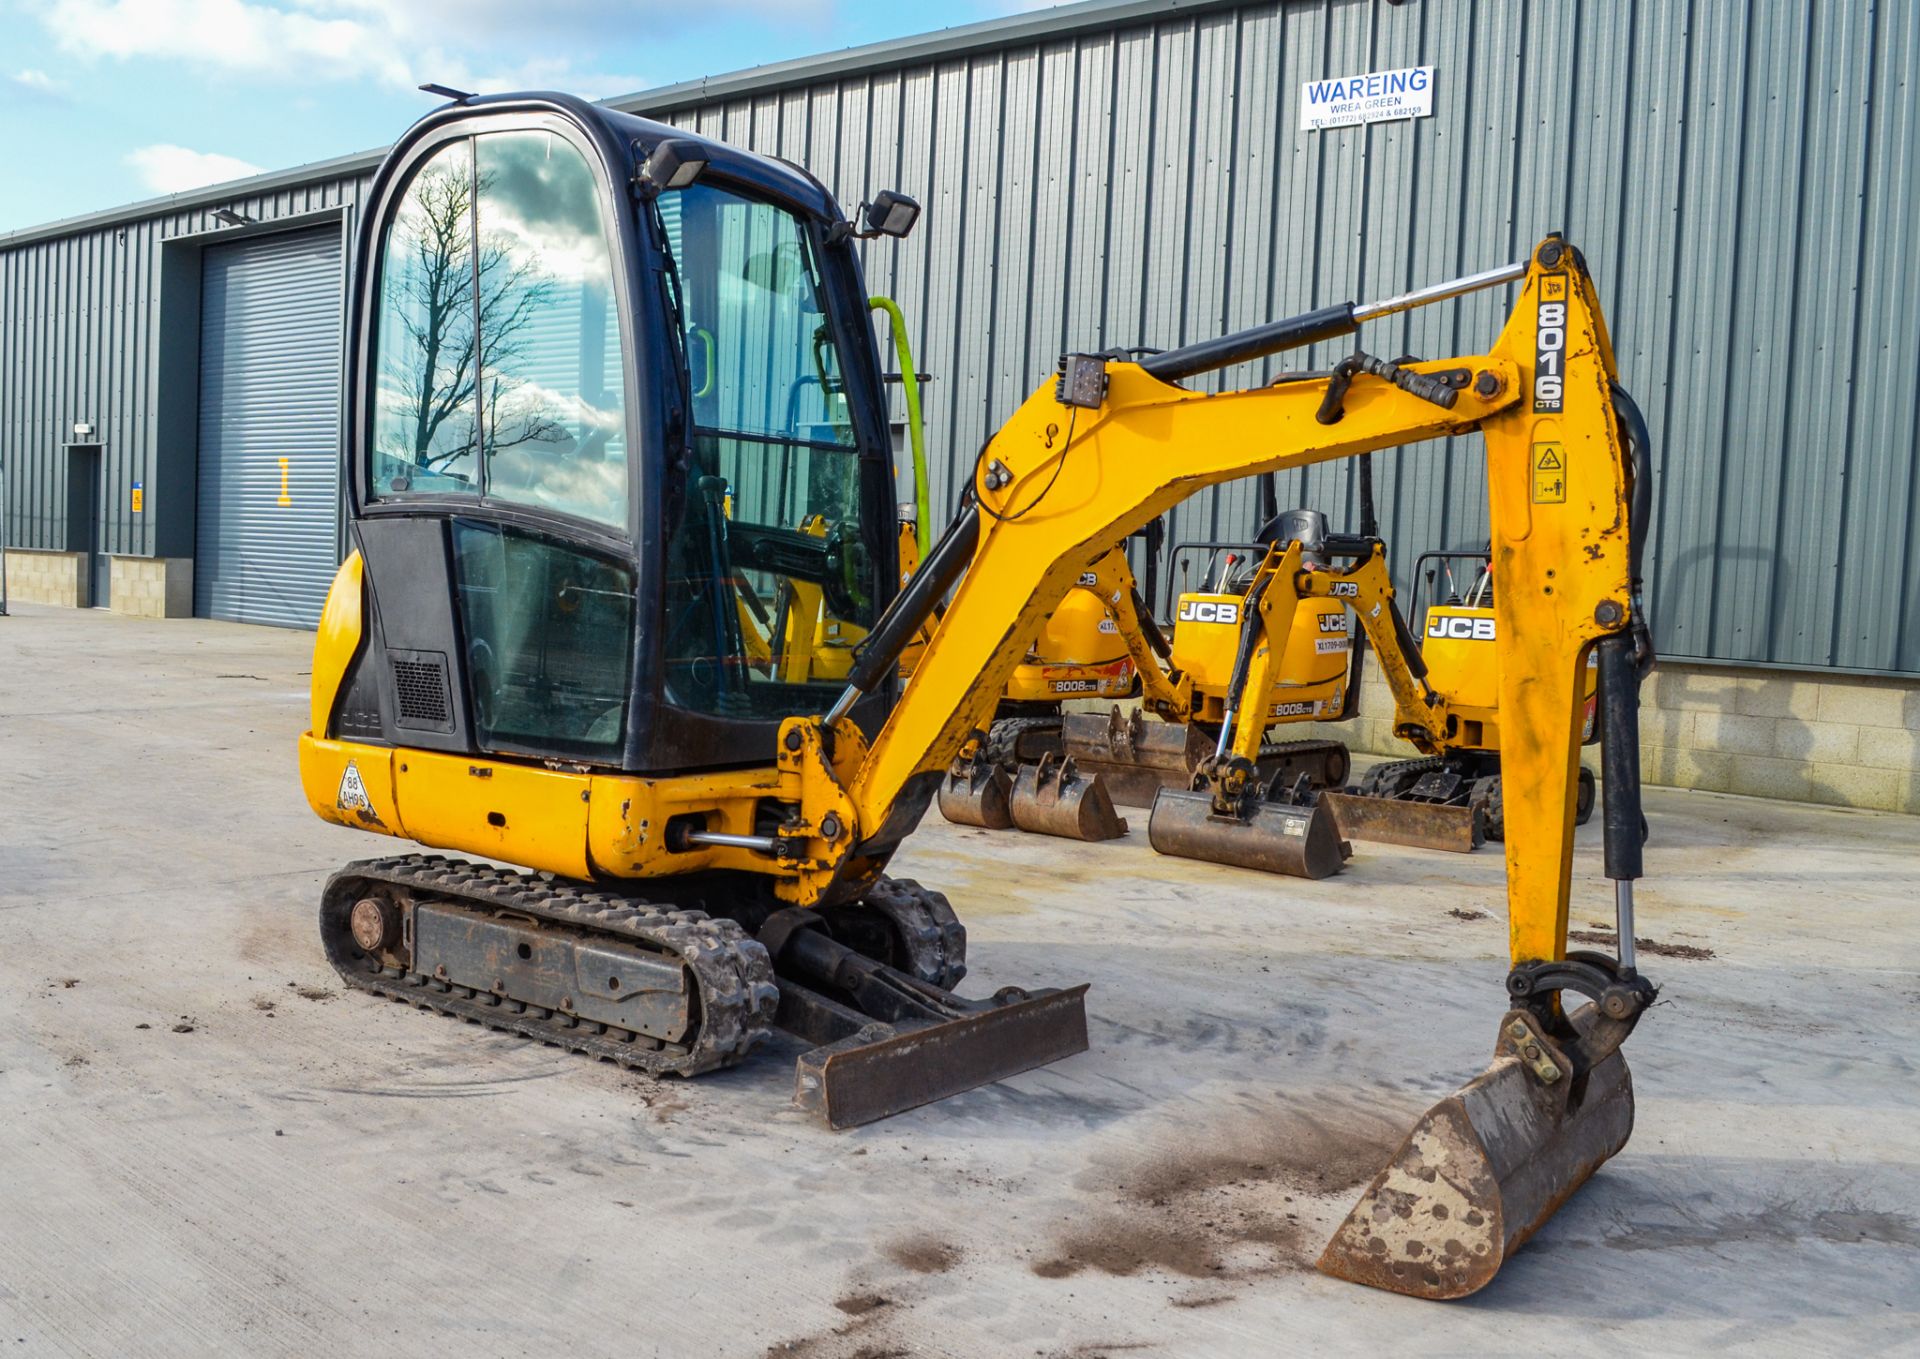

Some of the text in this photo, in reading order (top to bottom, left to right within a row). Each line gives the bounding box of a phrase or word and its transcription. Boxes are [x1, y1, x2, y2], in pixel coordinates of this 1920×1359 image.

[1308, 69, 1427, 105] WAREING
[1330, 96, 1401, 114] WREA GREEN
[1329, 114, 1357, 125] (01772)
[1535, 303, 1565, 400] 8016
[1535, 400, 1561, 408] CTS
[278, 457, 292, 507] 1
[1077, 573, 1097, 586] CB
[1329, 583, 1358, 597] JCB
[1180, 602, 1237, 624] JCB
[1320, 614, 1347, 631] JCB
[1428, 617, 1496, 640] JCB
[347, 776, 358, 790] 88
